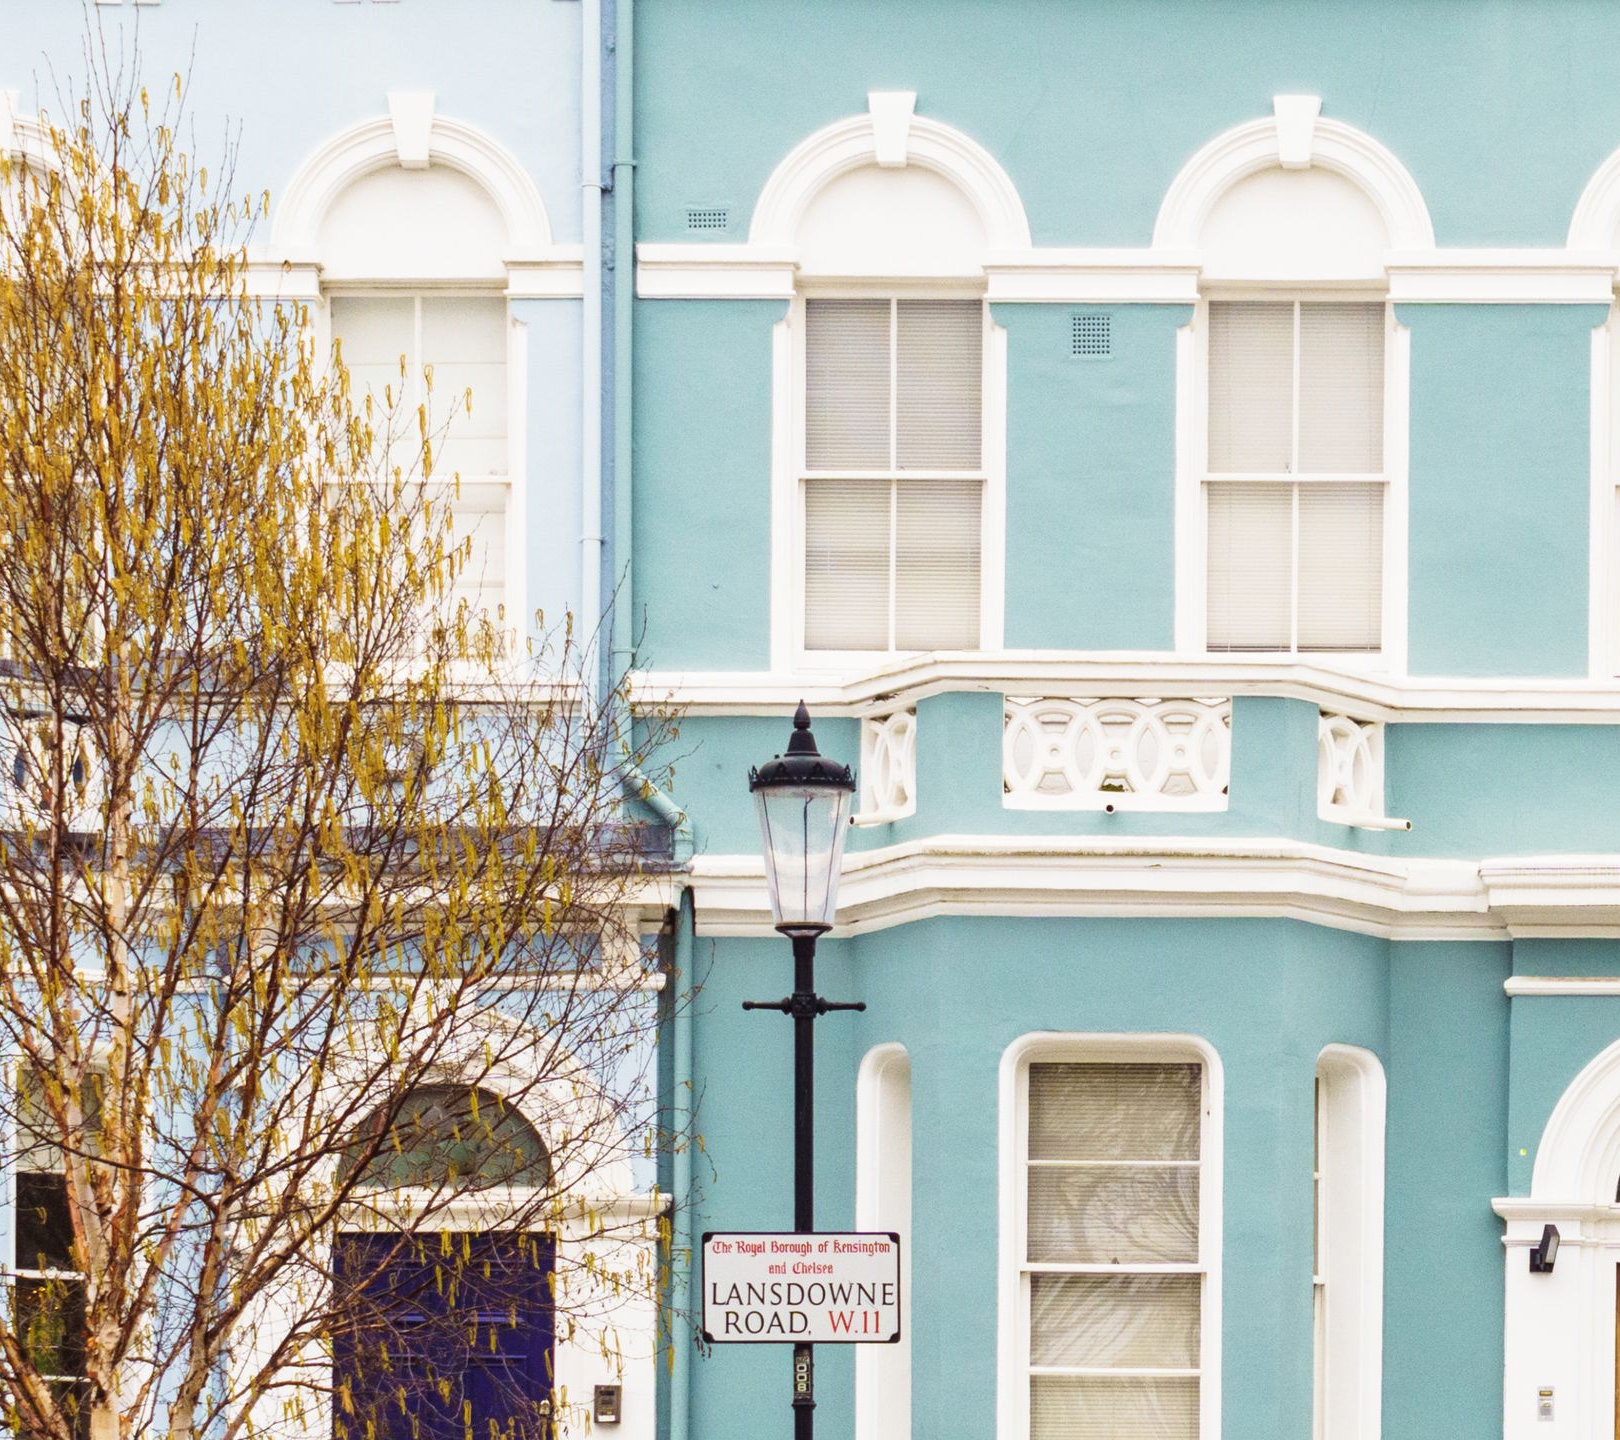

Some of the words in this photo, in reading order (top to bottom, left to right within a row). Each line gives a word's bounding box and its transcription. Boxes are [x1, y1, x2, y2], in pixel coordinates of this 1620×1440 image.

[712, 1241, 732, 1254] The
[736, 1240, 766, 1257] Royal
[771, 1241, 812, 1257] Borough
[818, 1240, 829, 1253] of
[833, 1239, 891, 1257] Kensington
[768, 1261, 786, 1274] and
[792, 1261, 833, 1274] Chelsea
[712, 1282, 895, 1306] LANSDOWNE
[829, 1311, 881, 1334] W.11
